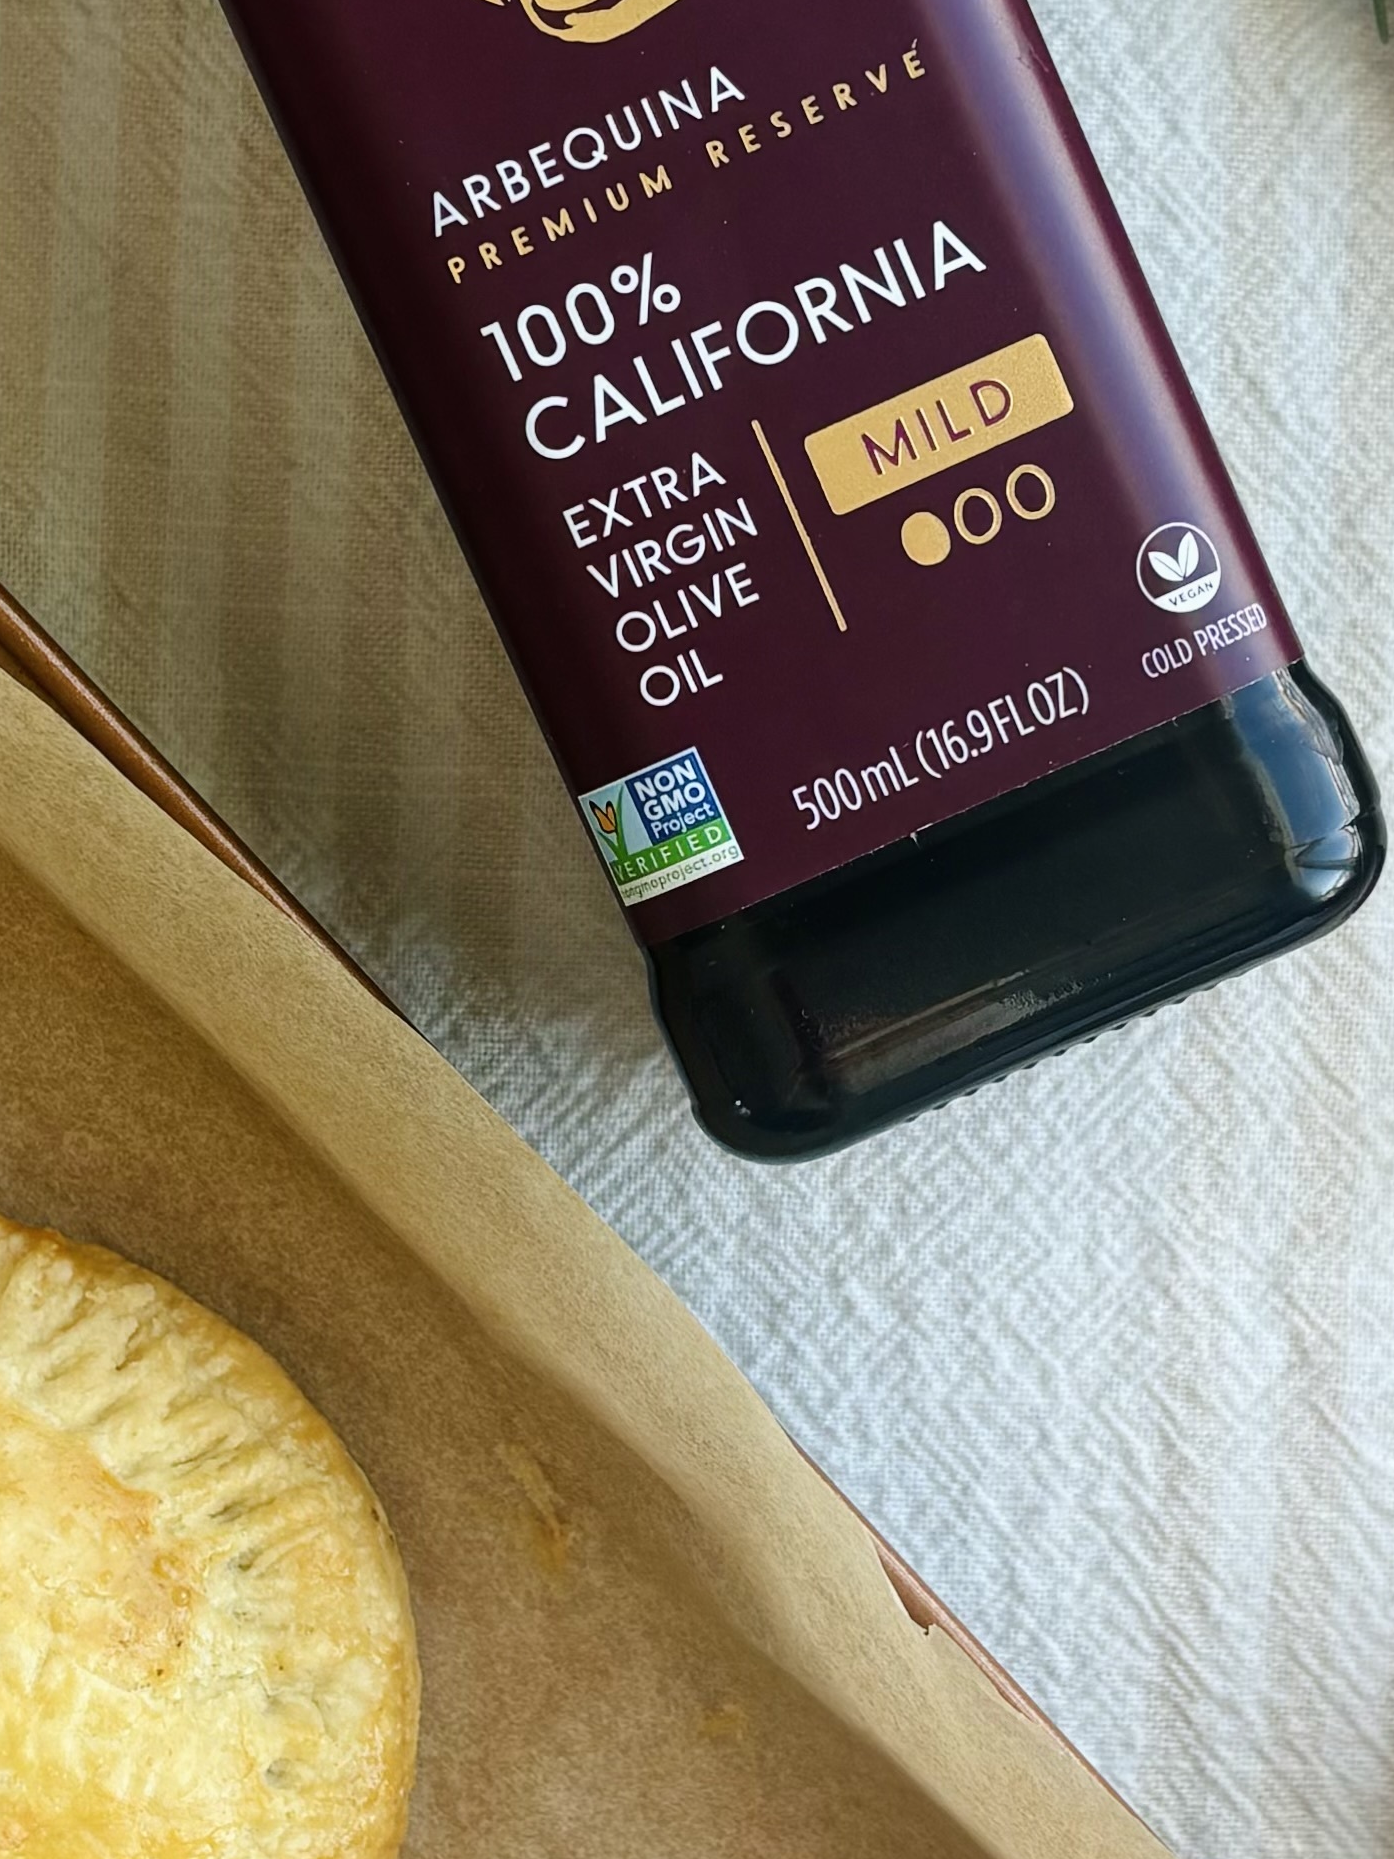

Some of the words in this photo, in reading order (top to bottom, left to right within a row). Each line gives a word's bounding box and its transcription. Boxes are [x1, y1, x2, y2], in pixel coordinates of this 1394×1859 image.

[433, 65, 746, 238] ARBEQUINA
[447, 164, 673, 284] PREMIUM
[479, 251, 682, 382] 100%
[525, 220, 987, 460] CALIFORNIA
[861, 378, 1015, 477] MILD
[562, 451, 726, 549] EXTRA
[586, 497, 758, 598] VIRGIN
[615, 562, 760, 653] OLIVE
[1168, 581, 1214, 607] VEGAN
[639, 648, 724, 707] OIL
[1141, 638, 1193, 678] COLD
[1193, 603, 1267, 656] PRESSED
[633, 759, 697, 802] NON
[643, 781, 706, 821] GMO
[650, 802, 715, 839] Project
[613, 825, 722, 881] VERIFIED
